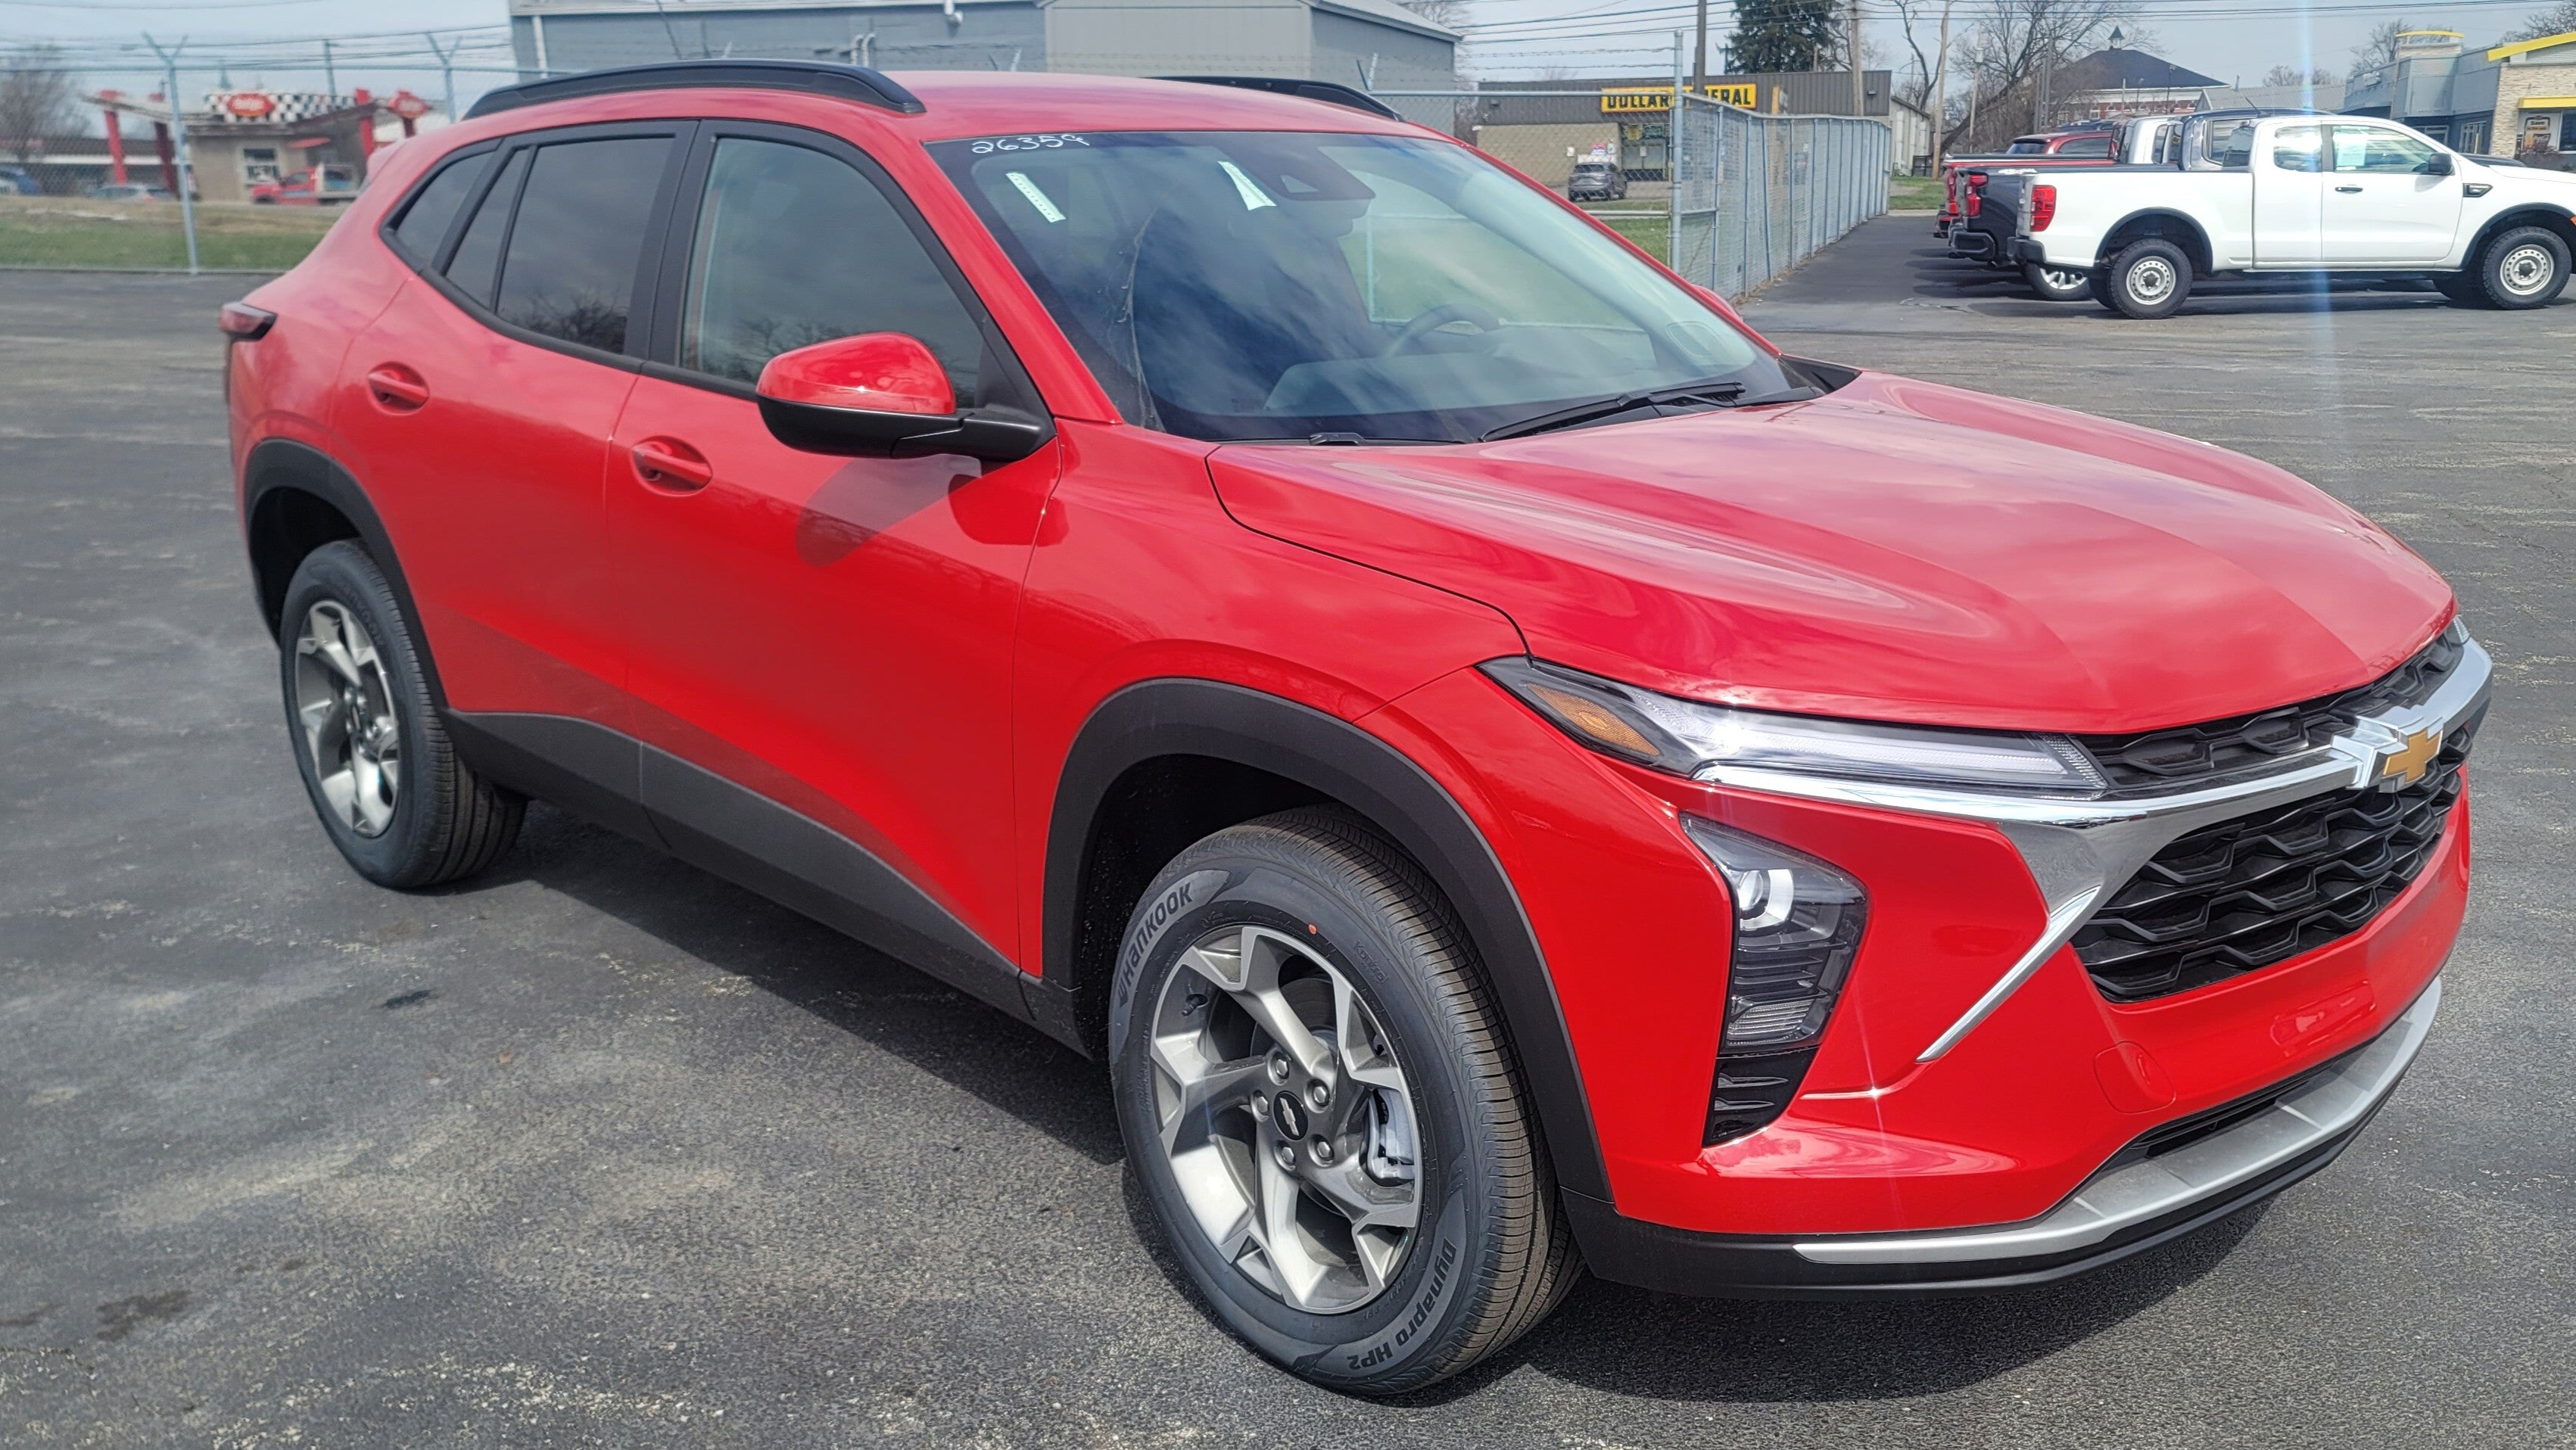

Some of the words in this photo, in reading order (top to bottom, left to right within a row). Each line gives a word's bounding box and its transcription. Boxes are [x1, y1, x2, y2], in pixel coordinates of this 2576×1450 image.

[972, 134, 1090, 154] 26359
[1394, 1237, 1457, 1346] Dynapro
[1347, 1342, 1393, 1370] HP2
